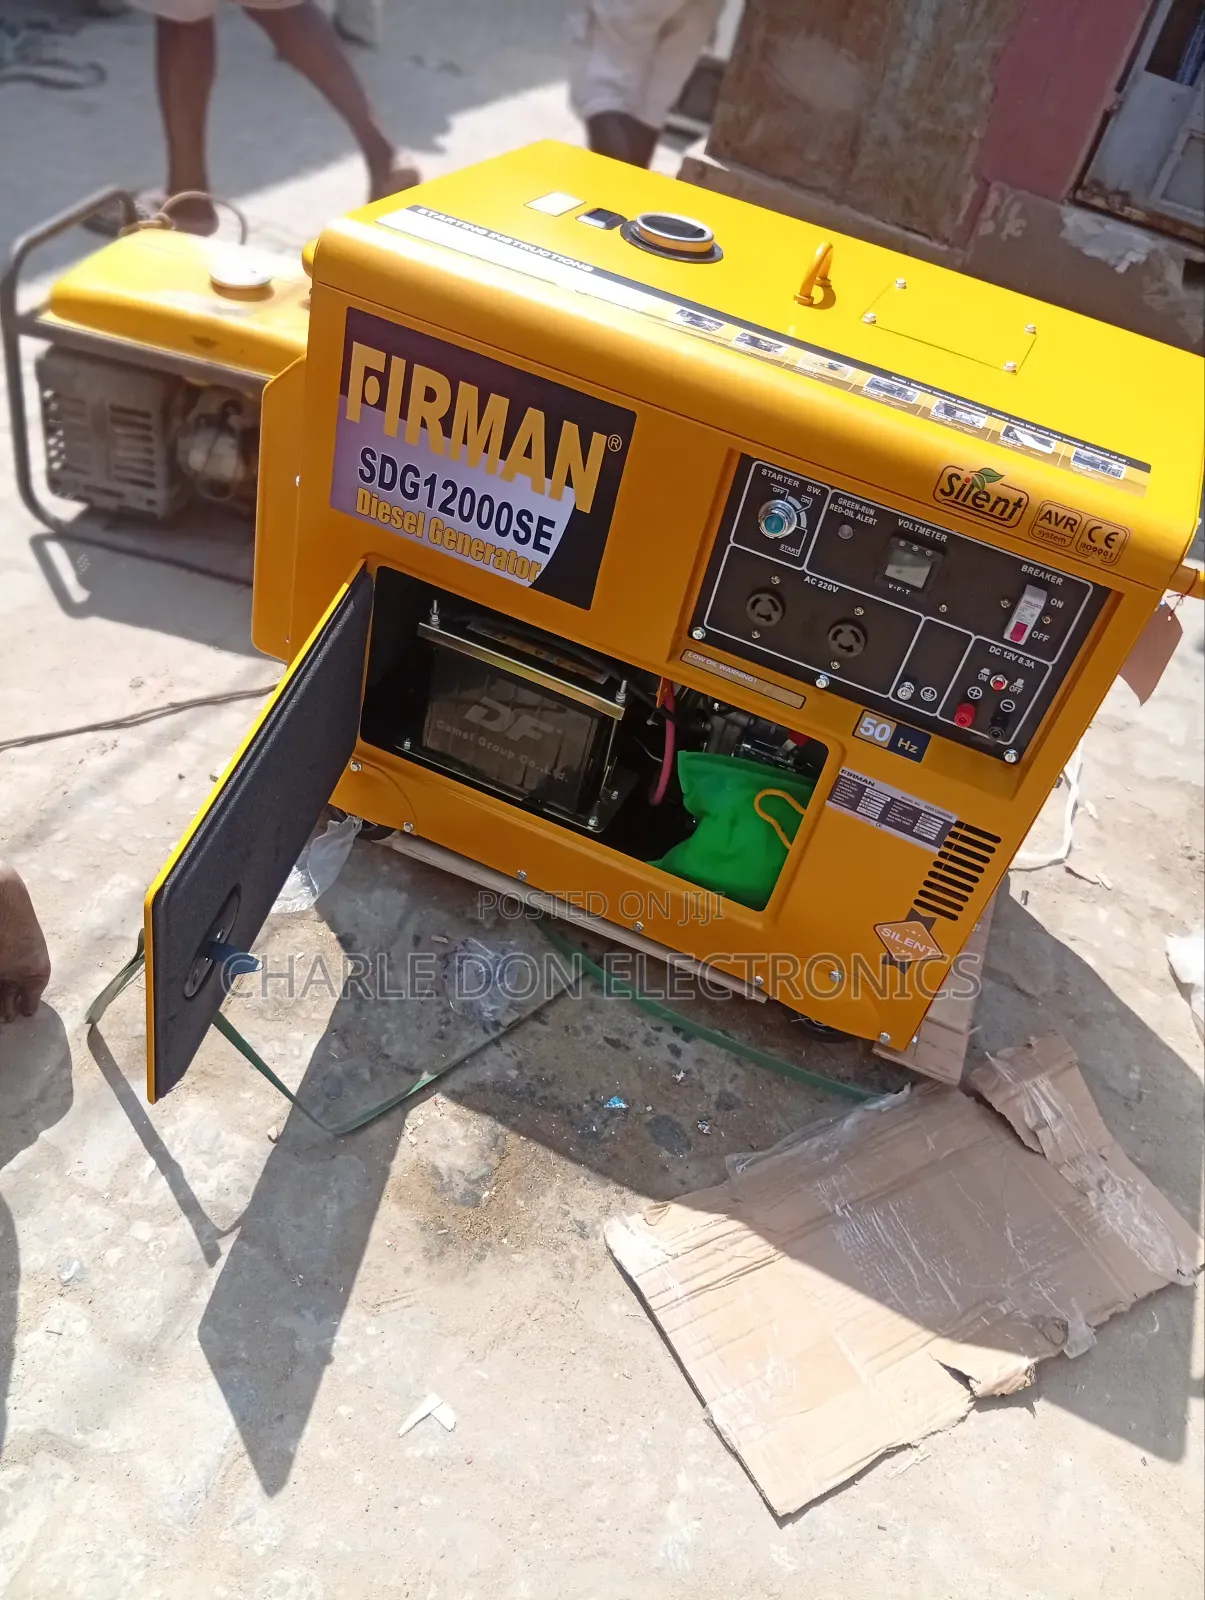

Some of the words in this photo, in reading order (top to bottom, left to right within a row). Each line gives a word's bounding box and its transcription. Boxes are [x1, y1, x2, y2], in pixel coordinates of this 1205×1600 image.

[417, 208, 487, 235] STARTING
[488, 231, 594, 272] INSTRUCTIONS
[346, 341, 608, 514] FIRMAN
[761, 468, 800, 488] STARTER
[806, 485, 822, 496] SW.
[772, 486, 785, 495] OFF
[357, 446, 556, 555] SDG12000SE
[800, 497, 810, 505] ON
[838, 497, 875, 516] GREEN-RUN
[939, 472, 1025, 521] Silent
[829, 503, 855, 518] RED-OIL
[856, 512, 878, 526] ALERT
[1039, 509, 1078, 533] AVR
[356, 487, 426, 538] Diesel
[428, 516, 543, 583] Generator
[897, 518, 948, 543] VOLTMETER
[1037, 529, 1067, 545] system
[1087, 525, 1120, 550] CE
[779, 543, 800, 556] START
[804, 575, 816, 585] AC
[817, 580, 839, 594] 220V
[1020, 564, 1063, 586] BREAKER
[1050, 597, 1064, 609] ON
[1031, 630, 1050, 642] OFF
[688, 652, 706, 663] LOW
[705, 659, 718, 668] OIL
[719, 664, 757, 684] WARNING!
[988, 645, 1002, 657] DC
[1003, 650, 1018, 662] 12V
[1017, 656, 1035, 669] 8.3A
[977, 673, 989, 682] ON
[1008, 685, 1023, 695] OFF
[859, 717, 892, 742] 50
[897, 737, 919, 754] Hz
[478, 737, 515, 759] Group
[840, 768, 876, 788] FIRMAN
[880, 927, 937, 956] SILENT
